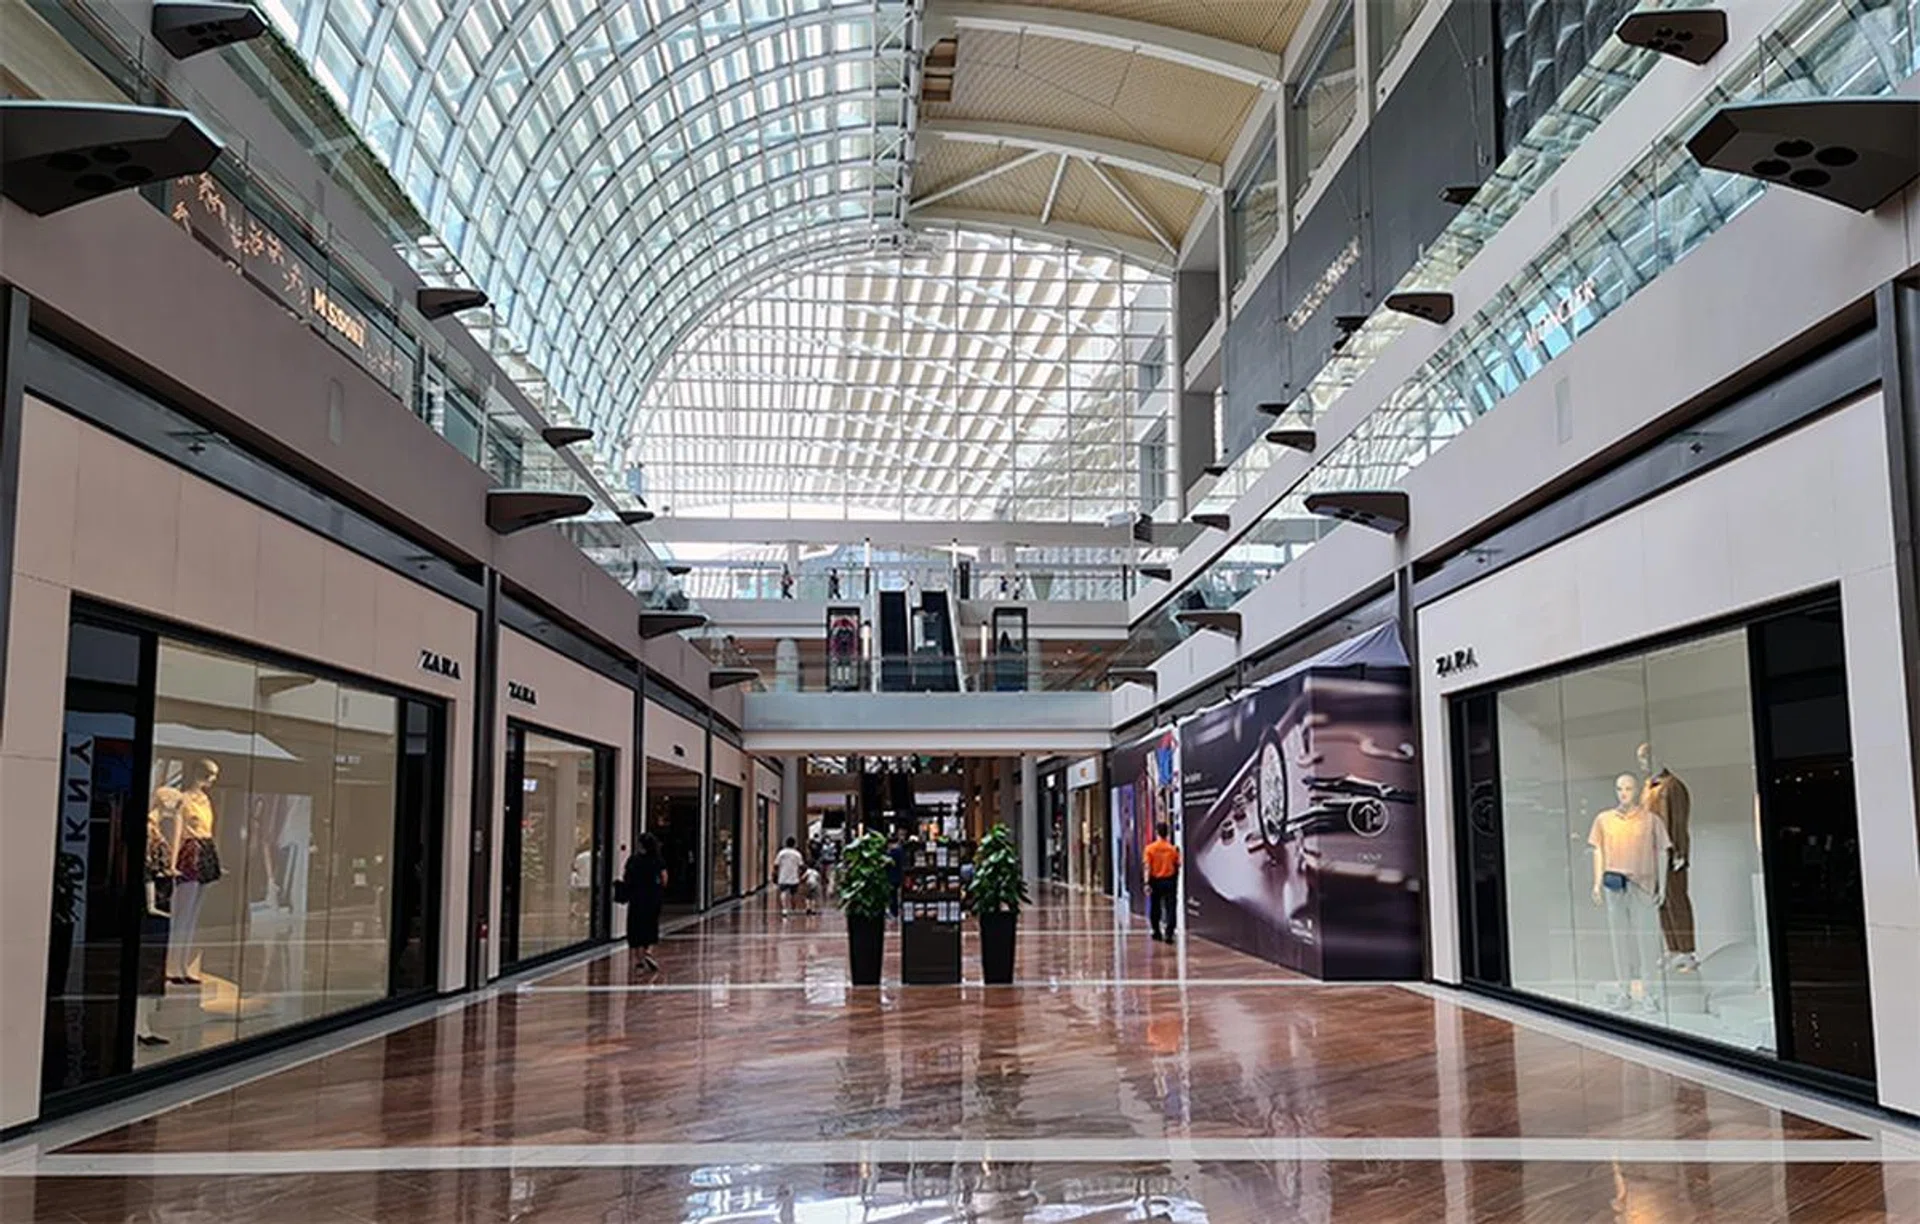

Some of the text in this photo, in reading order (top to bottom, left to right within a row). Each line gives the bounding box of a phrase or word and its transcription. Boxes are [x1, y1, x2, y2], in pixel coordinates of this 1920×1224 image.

[420, 651, 461, 680] ZARA
[1436, 647, 1478, 677] ZARA
[509, 682, 537, 706] ZARA
